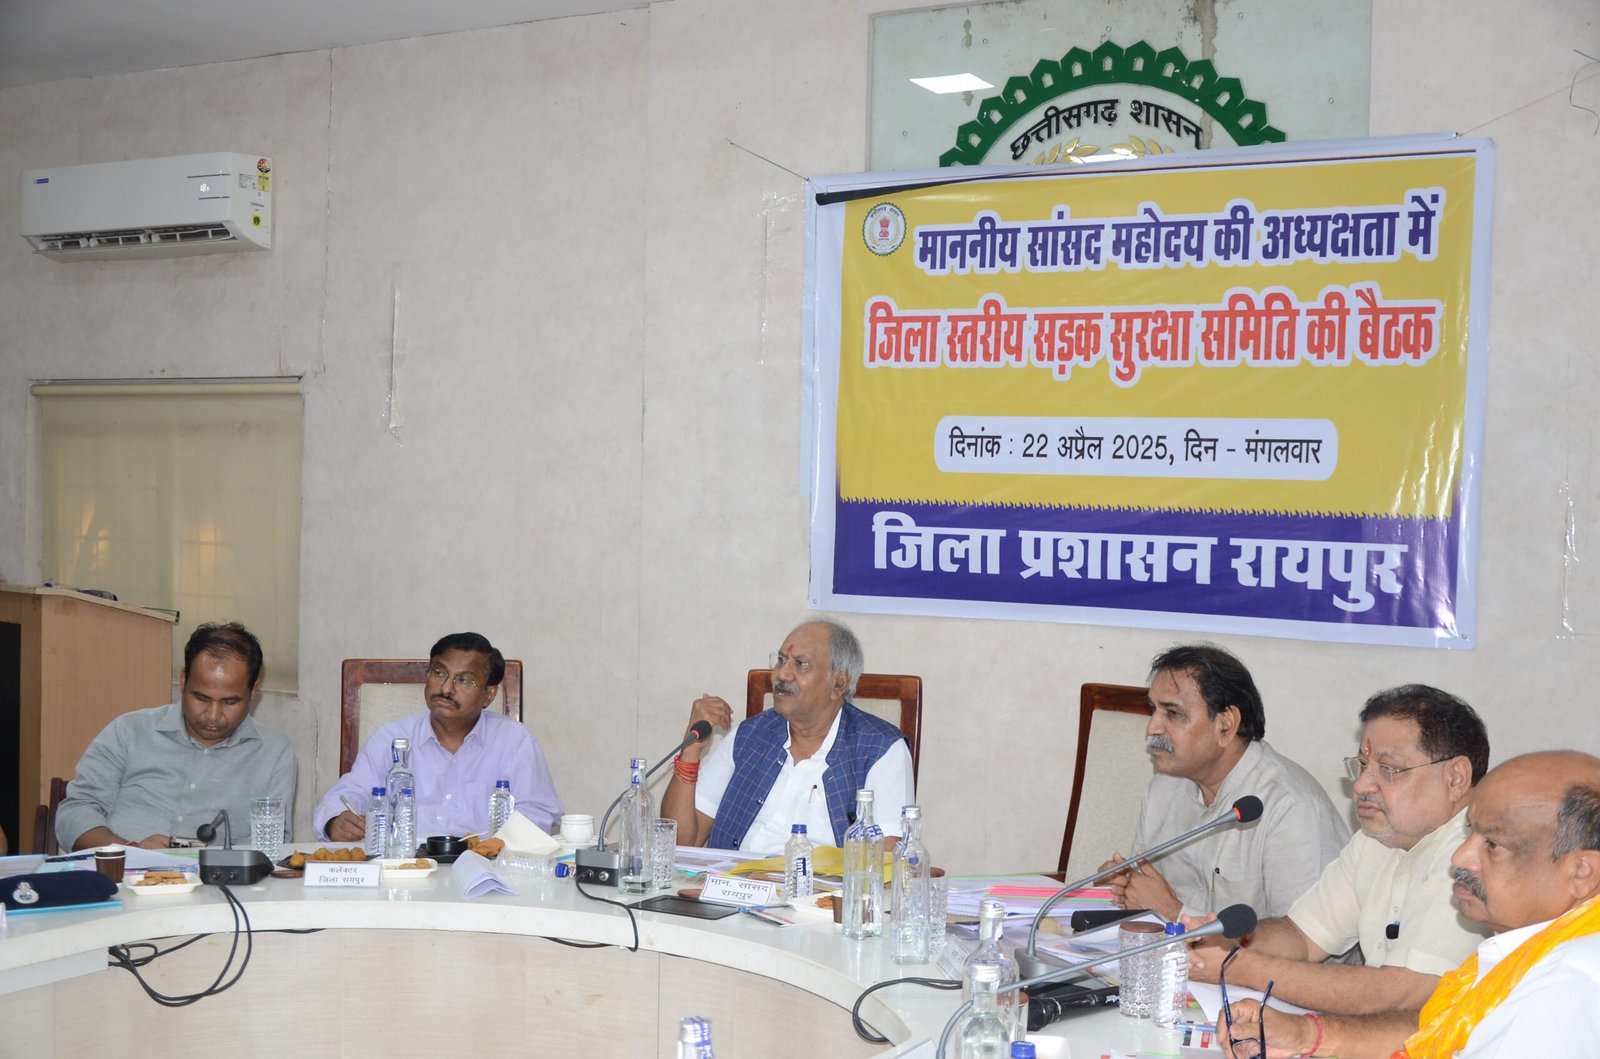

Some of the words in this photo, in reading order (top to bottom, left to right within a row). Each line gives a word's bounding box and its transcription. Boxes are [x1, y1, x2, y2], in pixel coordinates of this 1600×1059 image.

[1010, 99, 1119, 160] छत्तीसगढ़
[1130, 100, 1203, 149] शासन
[919, 217, 1018, 271] माननीय
[1027, 209, 1104, 267] सांसद
[1112, 206, 1205, 265] महोदय
[1214, 199, 1253, 262] की
[1263, 212, 1398, 260] अध्यक्षता
[1408, 193, 1440, 256] में
[868, 301, 941, 364] जिला
[947, 300, 1025, 364] स्तरीय
[1033, 313, 1104, 376] सड़क
[1110, 308, 1194, 382] सुरक्षा
[1201, 291, 1298, 361] समिति
[1306, 291, 1350, 361] की
[949, 426, 1002, 458] दिनांक
[1022, 437, 1048, 458] 22
[1057, 426, 1103, 460] अप्रैल
[1183, 430, 1219, 462] दिन
[1245, 431, 1322, 465] मंगलवार
[872, 511, 1006, 575] जिला
[1018, 529, 1216, 584] प्रशासन
[1230, 537, 1409, 613] रायपुर
[721, 889, 753, 900] रायपुर
